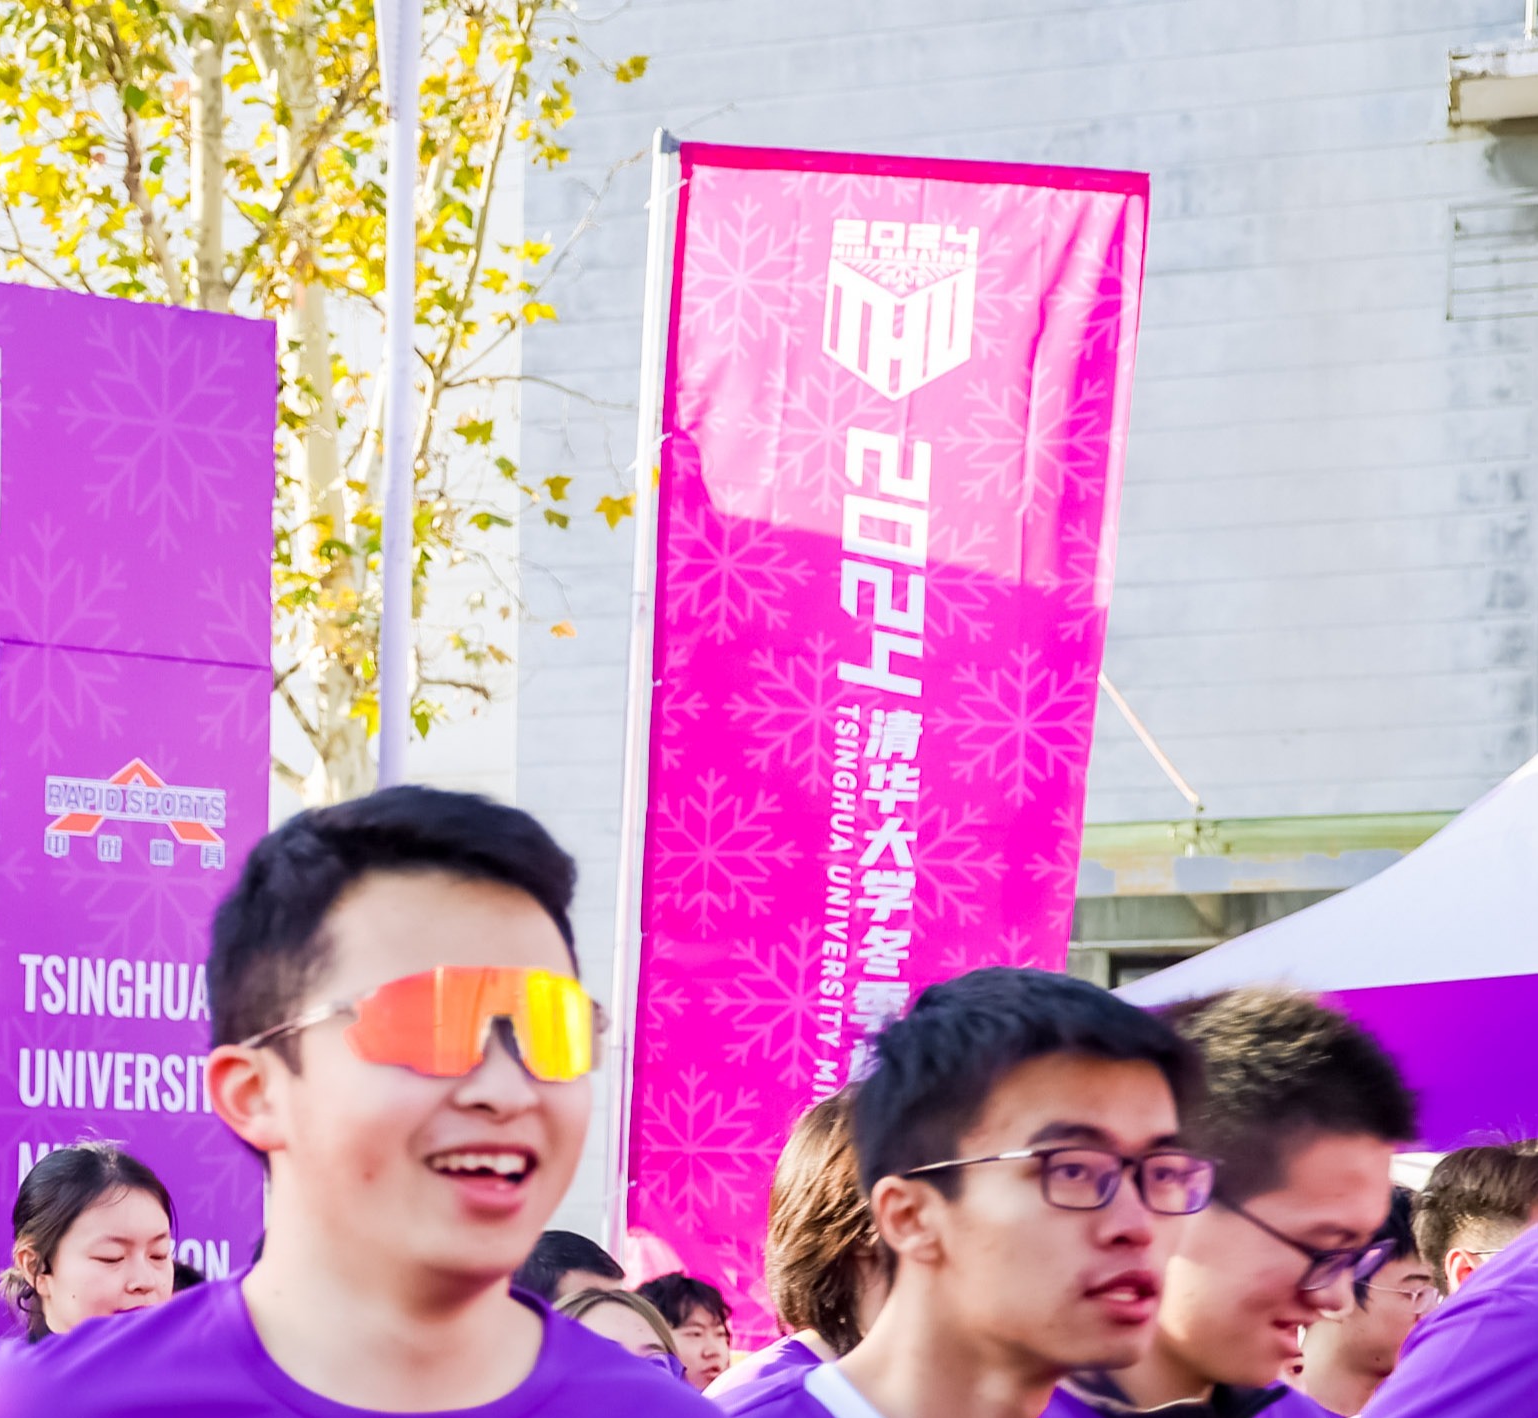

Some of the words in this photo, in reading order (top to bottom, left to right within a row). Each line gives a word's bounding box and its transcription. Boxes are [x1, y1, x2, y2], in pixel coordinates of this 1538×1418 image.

[832, 219, 980, 249] 2024
[836, 426, 932, 698] 2024
[829, 703, 861, 853] TSINGHUA
[815, 864, 853, 1048] UNIVERSITY
[848, 708, 924, 1082] 清华大学冬季
[18, 1048, 213, 1113] UNIVERSIT
[810, 1058, 839, 1102] MI
